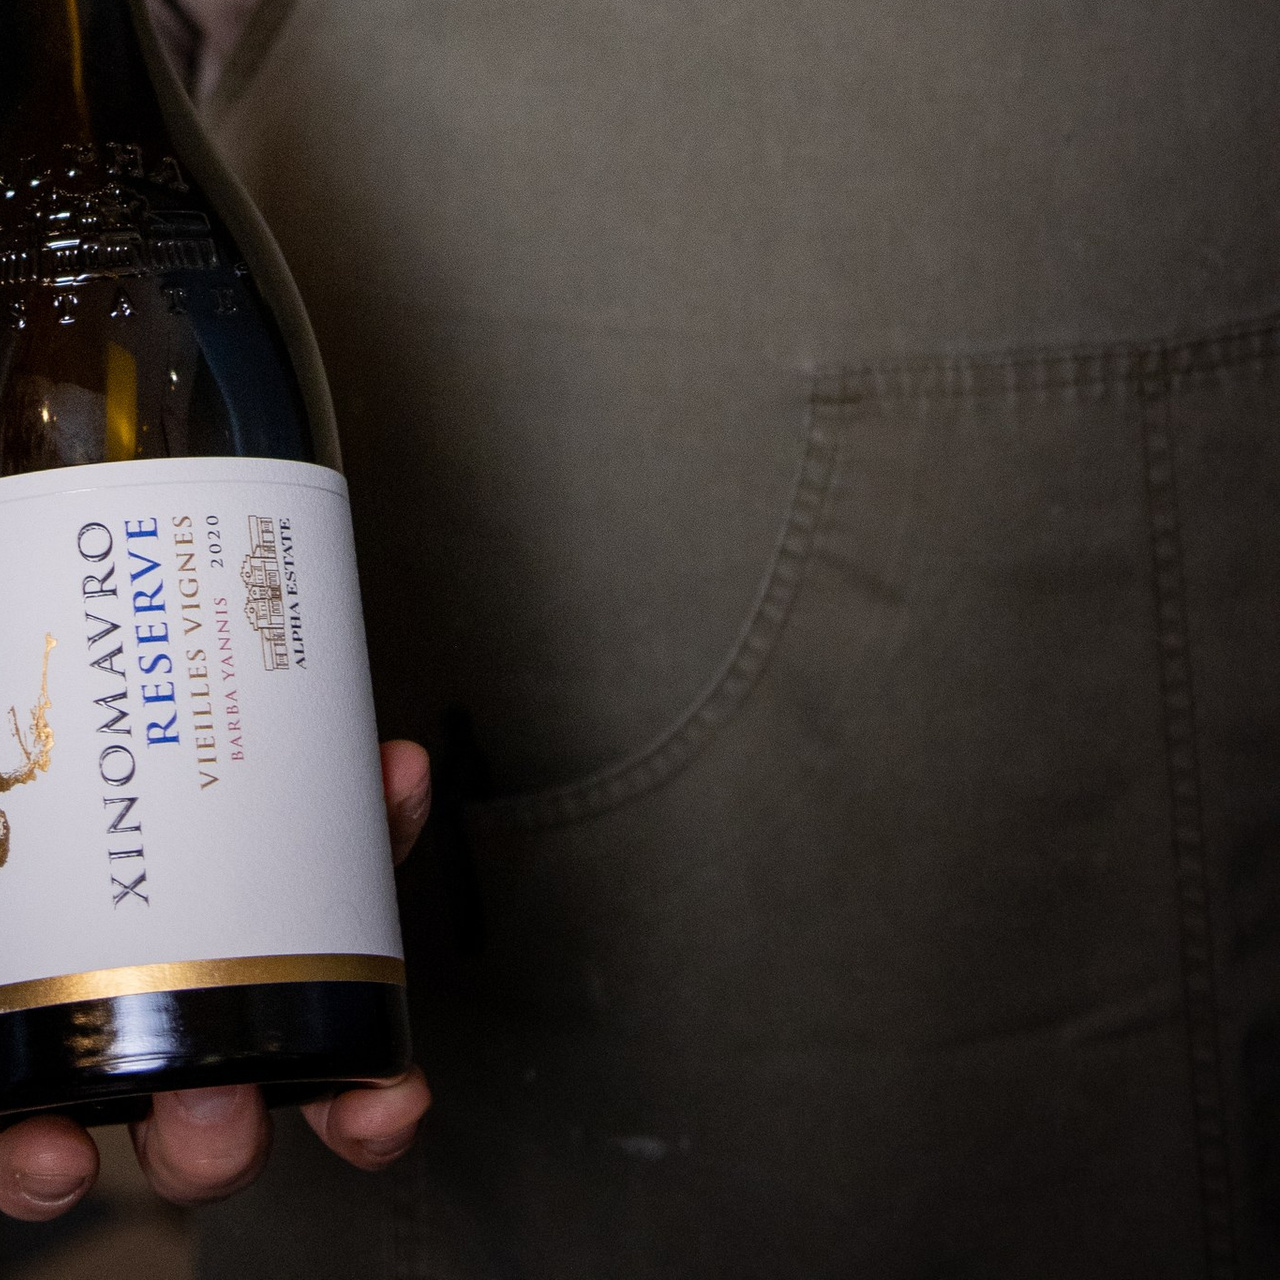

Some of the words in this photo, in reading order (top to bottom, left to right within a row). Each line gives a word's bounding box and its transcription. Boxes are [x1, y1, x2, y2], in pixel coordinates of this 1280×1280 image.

[172, 515, 201, 635] VIGNES
[205, 515, 223, 568] 2020
[279, 518, 299, 596] ESTATE
[125, 517, 180, 747] RESERVE
[215, 596, 236, 682] YANNIS
[289, 602, 307, 670] ALPHA
[77, 522, 149, 909] XINOMAVRO
[186, 648, 220, 790] VIEILLES
[225, 689, 244, 762] BARBA
